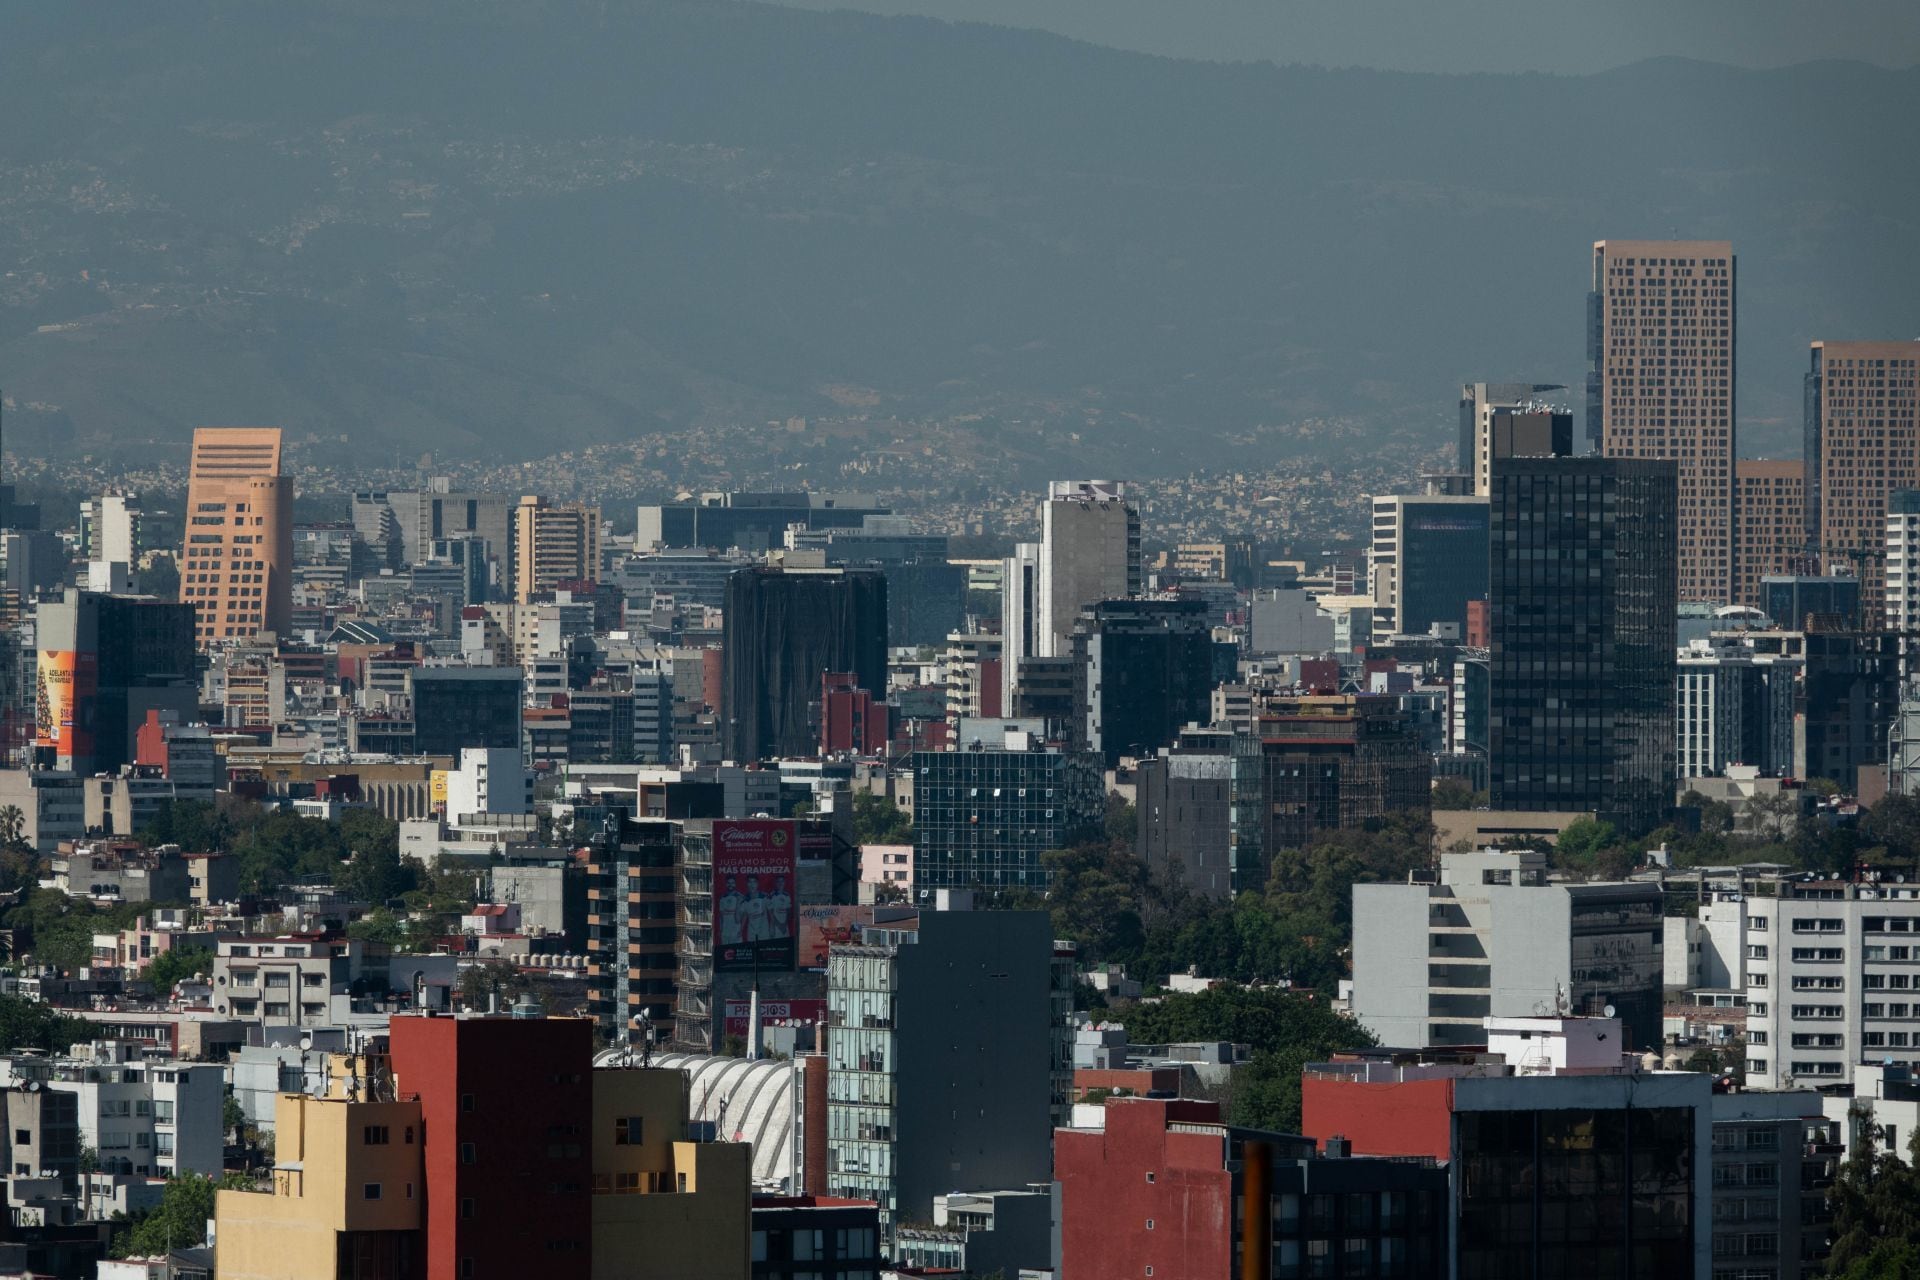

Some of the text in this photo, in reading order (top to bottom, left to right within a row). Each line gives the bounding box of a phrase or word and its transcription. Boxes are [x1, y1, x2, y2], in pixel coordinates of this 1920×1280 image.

[719, 857, 790, 866] JUGAMOS POR
[739, 866, 790, 874] GRANDEZA
[734, 1004, 786, 1016] PRCIOS
